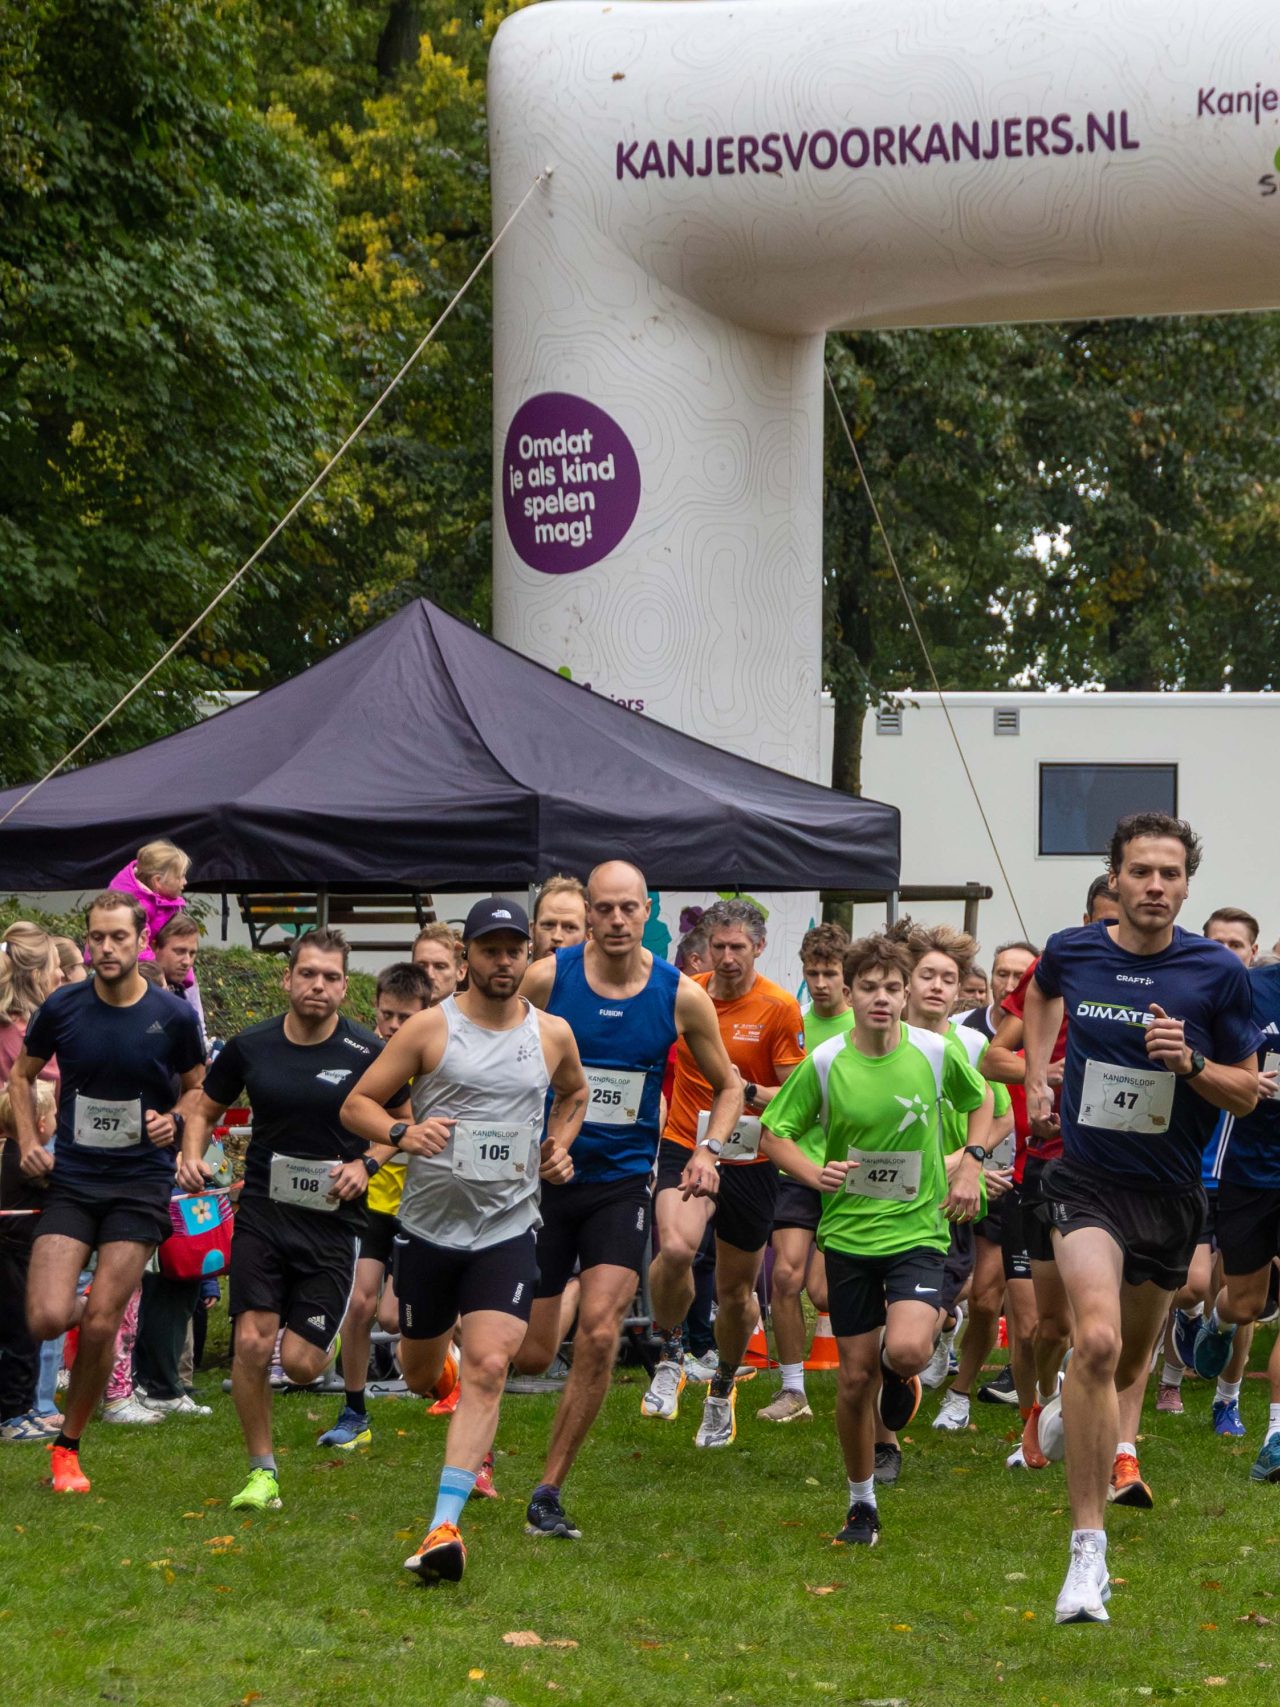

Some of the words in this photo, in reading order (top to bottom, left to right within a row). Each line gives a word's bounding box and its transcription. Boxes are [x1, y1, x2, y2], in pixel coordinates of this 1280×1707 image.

[615, 110, 1140, 180] KANJERSVOORKANJERS.NL
[518, 428, 593, 460] Omdat
[509, 464, 523, 497] je
[528, 459, 556, 488] als
[561, 453, 615, 484] kind
[523, 486, 595, 522] spelen
[534, 514, 593, 547] mag!
[1116, 974, 1146, 984] CRAFT
[599, 1008, 624, 1018] FUSION
[1076, 1003, 1185, 1025] DIMATE
[592, 1088, 622, 1106] 255
[1113, 1090, 1139, 1110] 47
[93, 1117, 120, 1131] 257
[479, 1143, 510, 1161] 105
[291, 1176, 319, 1193] 108
[867, 1169, 898, 1183] 427
[512, 1282, 524, 1305] FUSION
